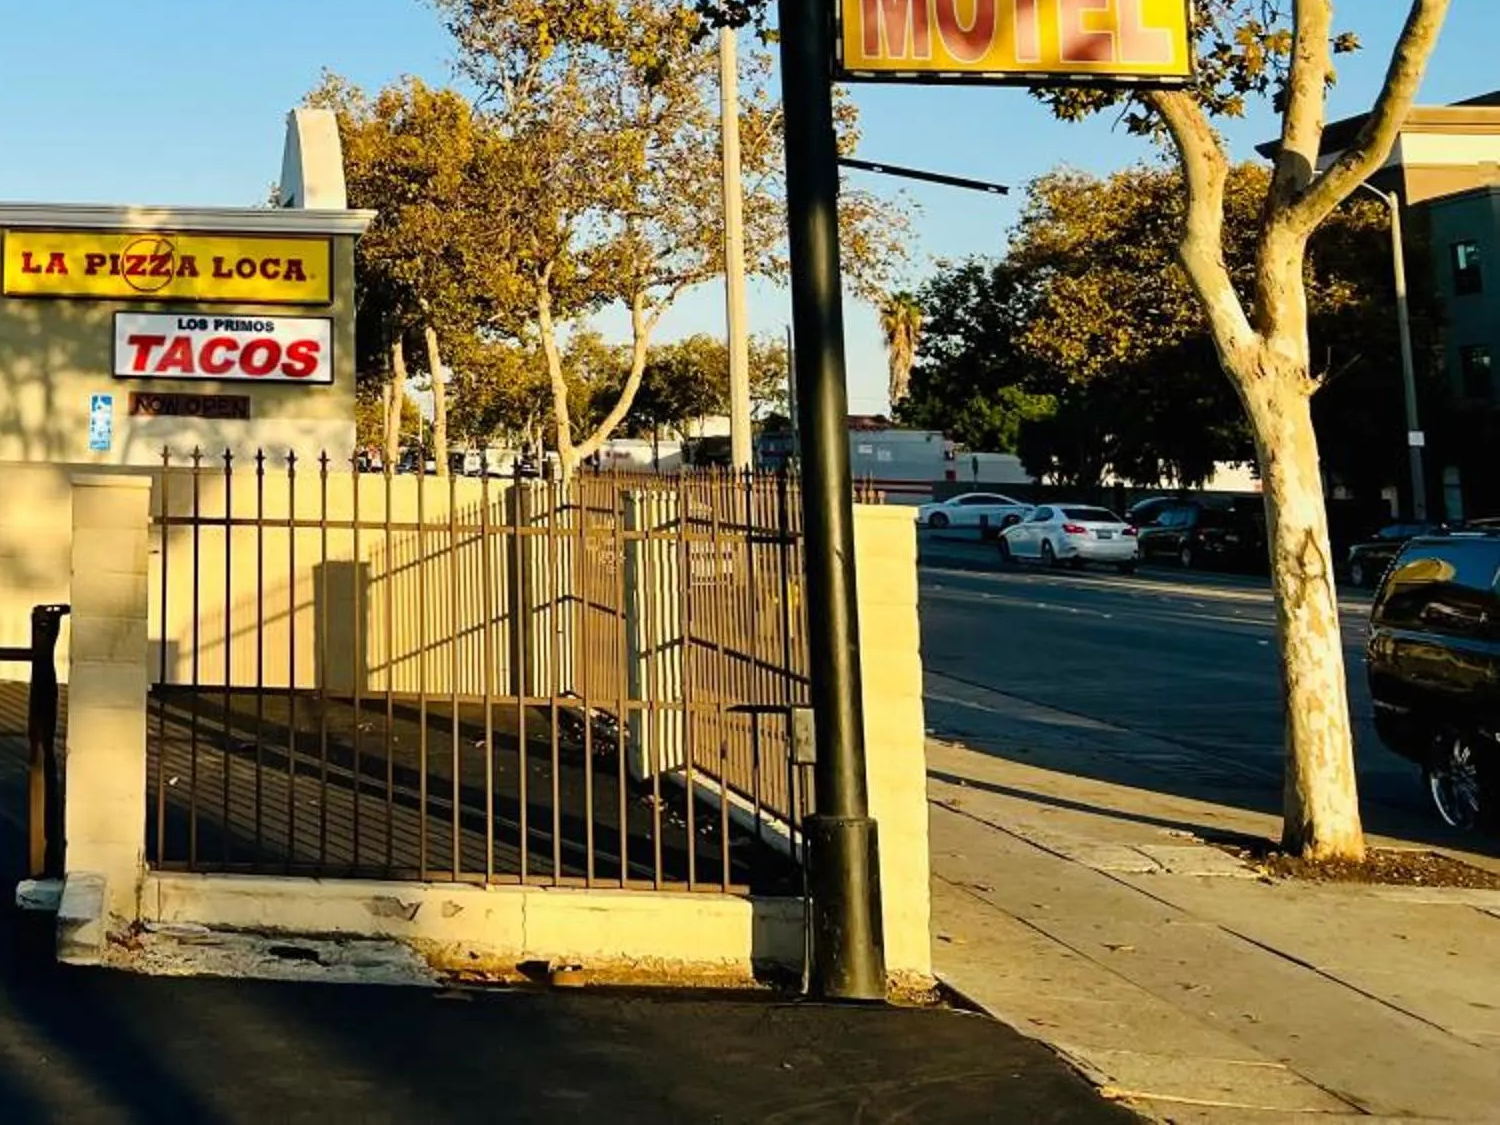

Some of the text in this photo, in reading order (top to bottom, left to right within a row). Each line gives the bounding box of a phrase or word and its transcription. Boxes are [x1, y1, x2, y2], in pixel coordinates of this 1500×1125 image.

[21, 252, 307, 282] LA PIZZA LOCA
[177, 318, 275, 332] LOS PRIMOS
[127, 334, 321, 377] TACOS
